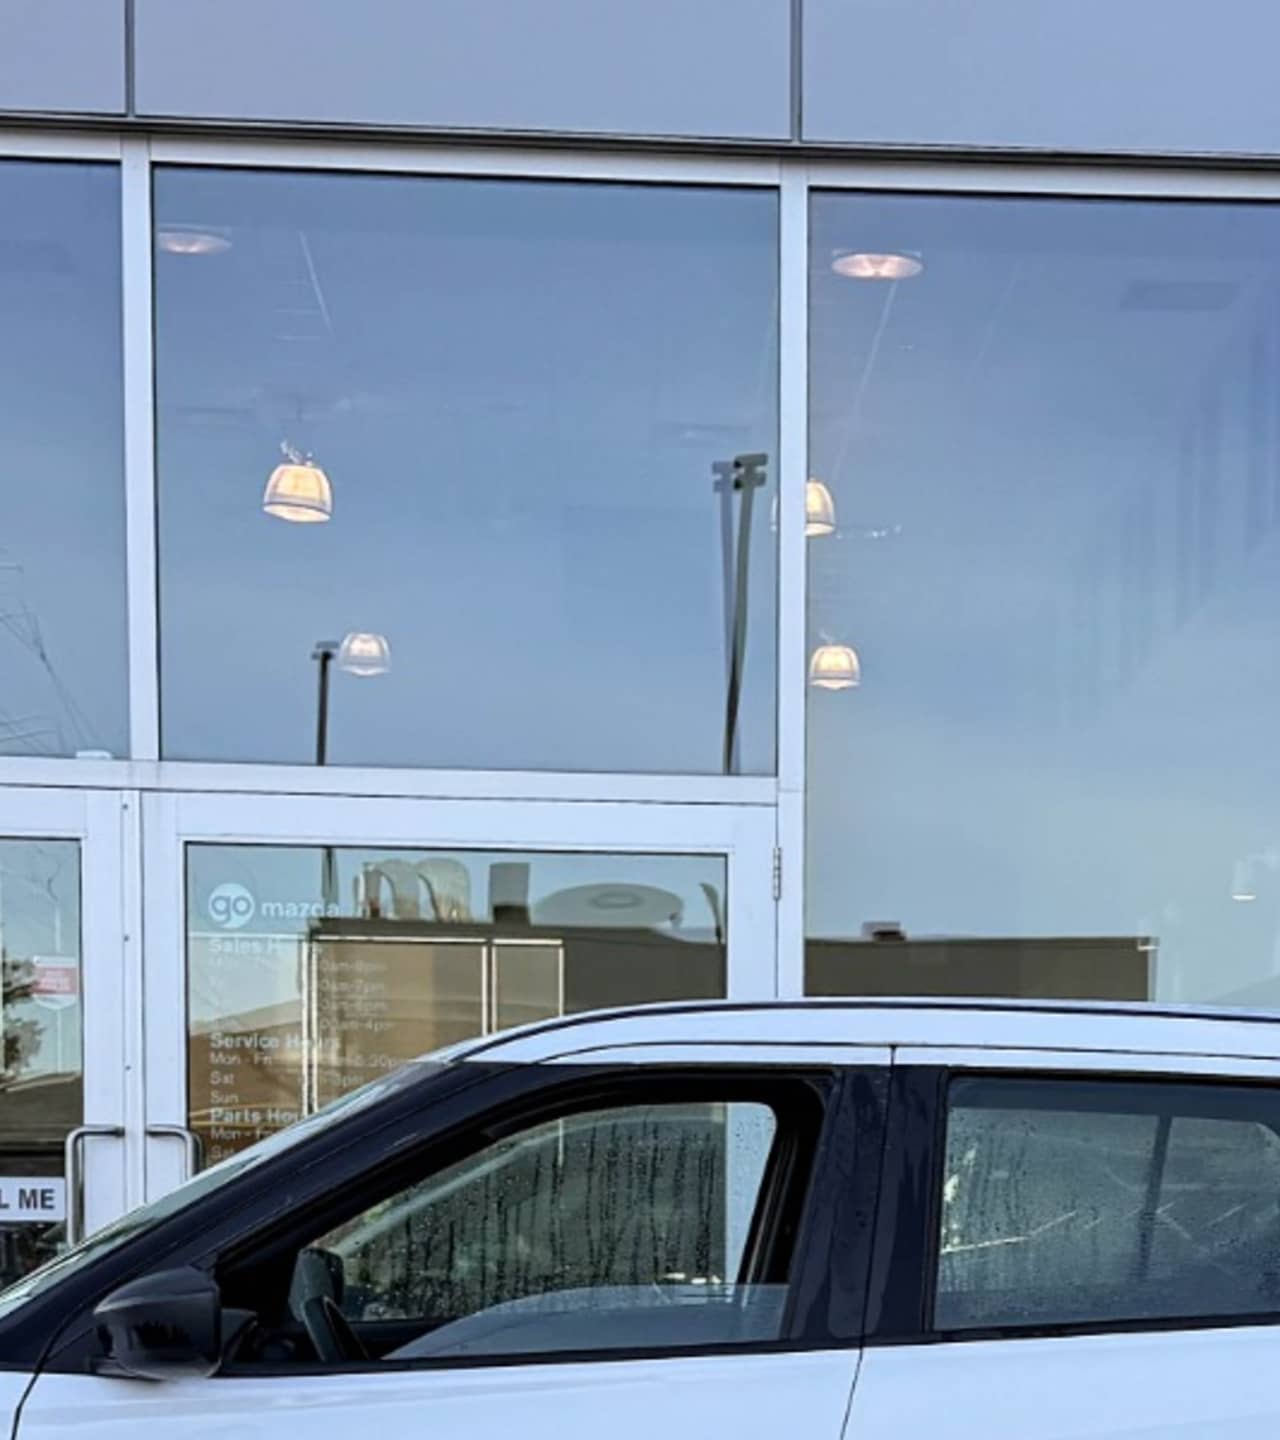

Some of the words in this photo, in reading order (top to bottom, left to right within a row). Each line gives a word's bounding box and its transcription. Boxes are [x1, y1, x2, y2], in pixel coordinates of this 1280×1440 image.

[210, 893, 252, 924] go
[210, 1032, 279, 1048] Service
[210, 1052, 240, 1066] Mon
[210, 1107, 261, 1123] Parts
[18, 1188, 56, 1210] ME
